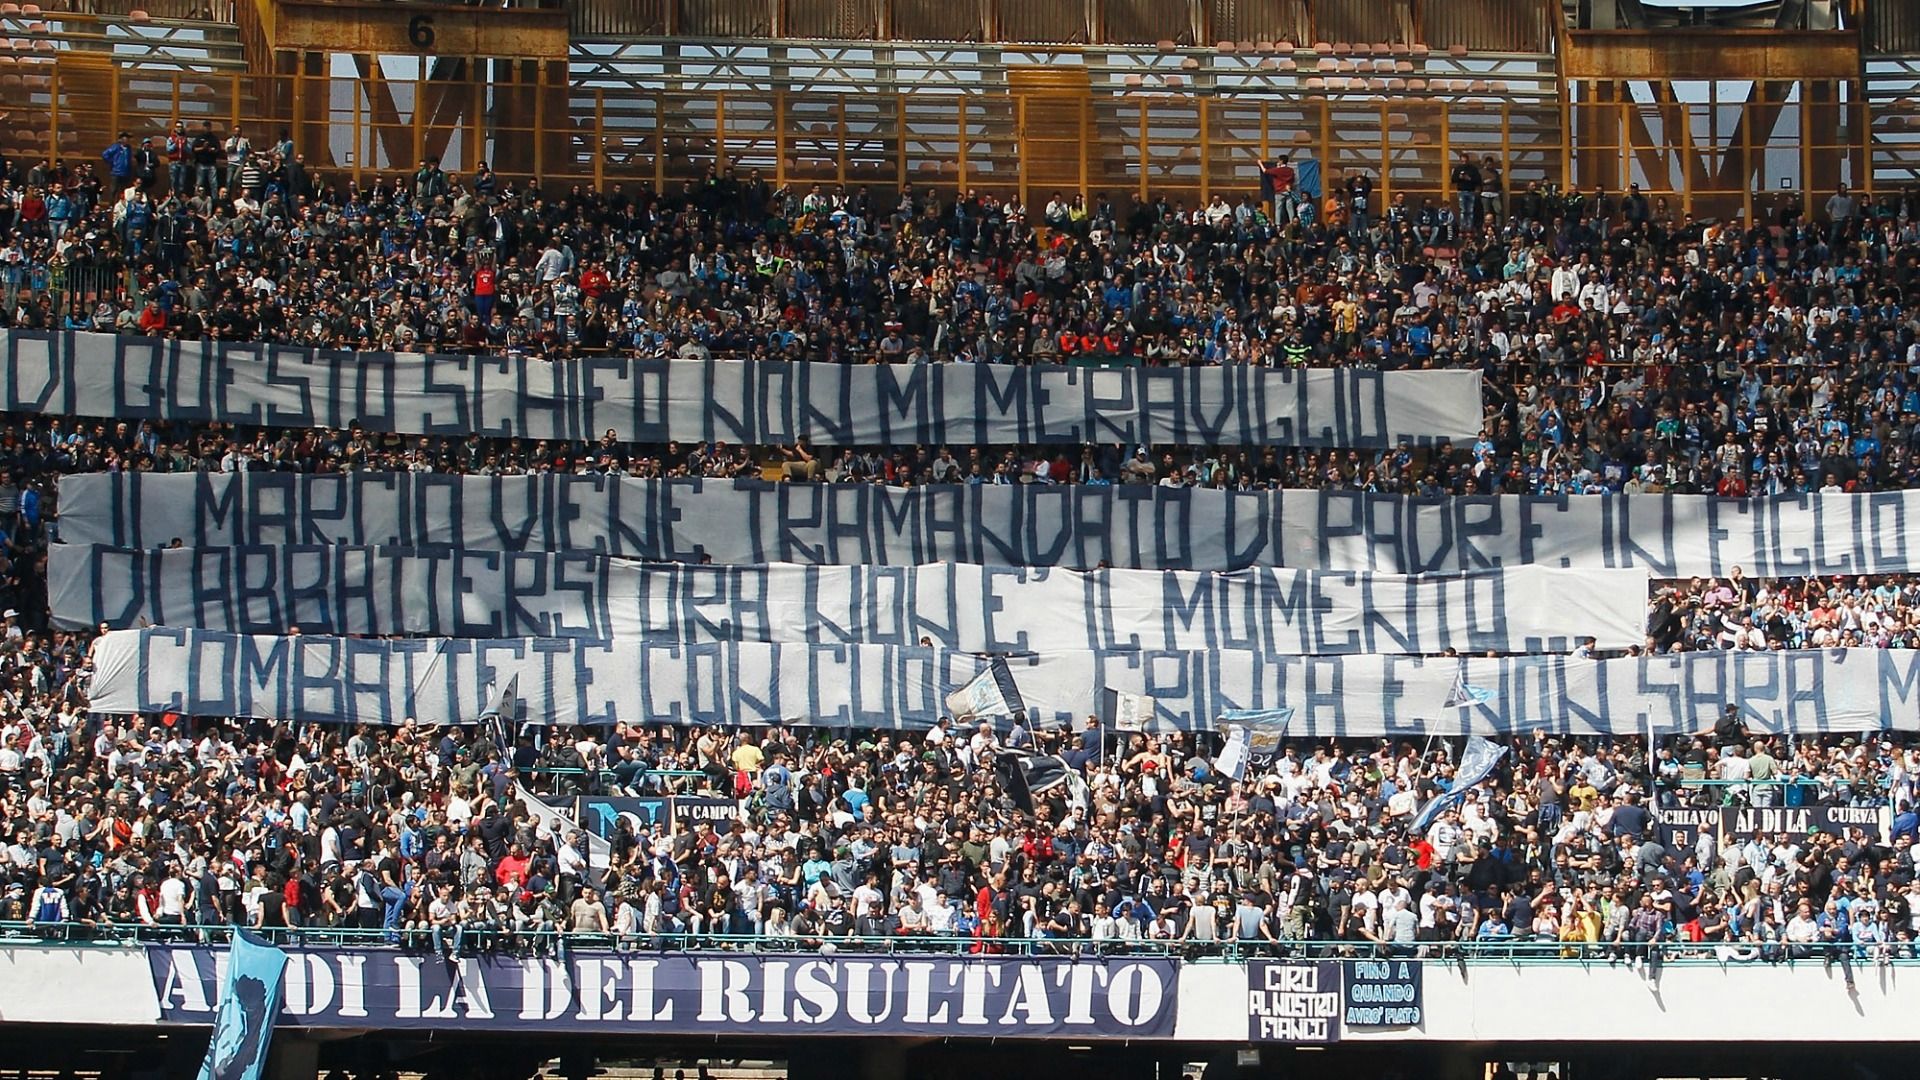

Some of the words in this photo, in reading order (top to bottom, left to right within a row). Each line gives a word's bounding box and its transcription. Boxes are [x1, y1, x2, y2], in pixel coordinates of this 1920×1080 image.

[408, 14, 434, 48] 6
[8, 330, 75, 415] DI
[115, 335, 395, 432] QUESTO
[425, 354, 670, 440] SCHIFO
[704, 360, 855, 445] NON
[876, 363, 945, 445] MI
[196, 471, 463, 546] MARCIO
[491, 475, 704, 557] VIENE
[734, 479, 1192, 568] TRAMANDATO
[1225, 490, 1284, 570] DI
[1318, 491, 1570, 573] PADRE
[1602, 494, 1676, 578] IN
[1707, 492, 1908, 578] FIGLIO
[91, 543, 163, 627] DI
[193, 545, 613, 640] ABBATTERSI
[640, 562, 771, 643] ORA
[805, 563, 958, 650] NON
[982, 565, 1050, 652] E'
[1083, 567, 1141, 651] IL
[138, 627, 617, 726] COMBATTETE
[641, 640, 781, 728] CON
[1384, 656, 1425, 735] E
[1458, 655, 1610, 736] NON
[1637, 648, 1848, 736] SARA'
[692, 805, 737, 820] CAMPO
[1735, 809, 1758, 832] AL
[1762, 809, 1781, 832] DI
[1827, 807, 1878, 824] CURVA
[1265, 965, 1318, 993] CIRO
[1355, 961, 1390, 980] FINO
[1398, 962, 1410, 980] A
[282, 952, 368, 1017] DI
[394, 955, 495, 1019] LA
[518, 957, 675, 1022] DEL
[697, 960, 1164, 1027] RISULTATO
[1351, 984, 1415, 1002] QUANDO
[1250, 990, 1271, 1016] AL
[1272, 992, 1338, 1017] NOSTRO
[1260, 1017, 1328, 1040] FIANCO
